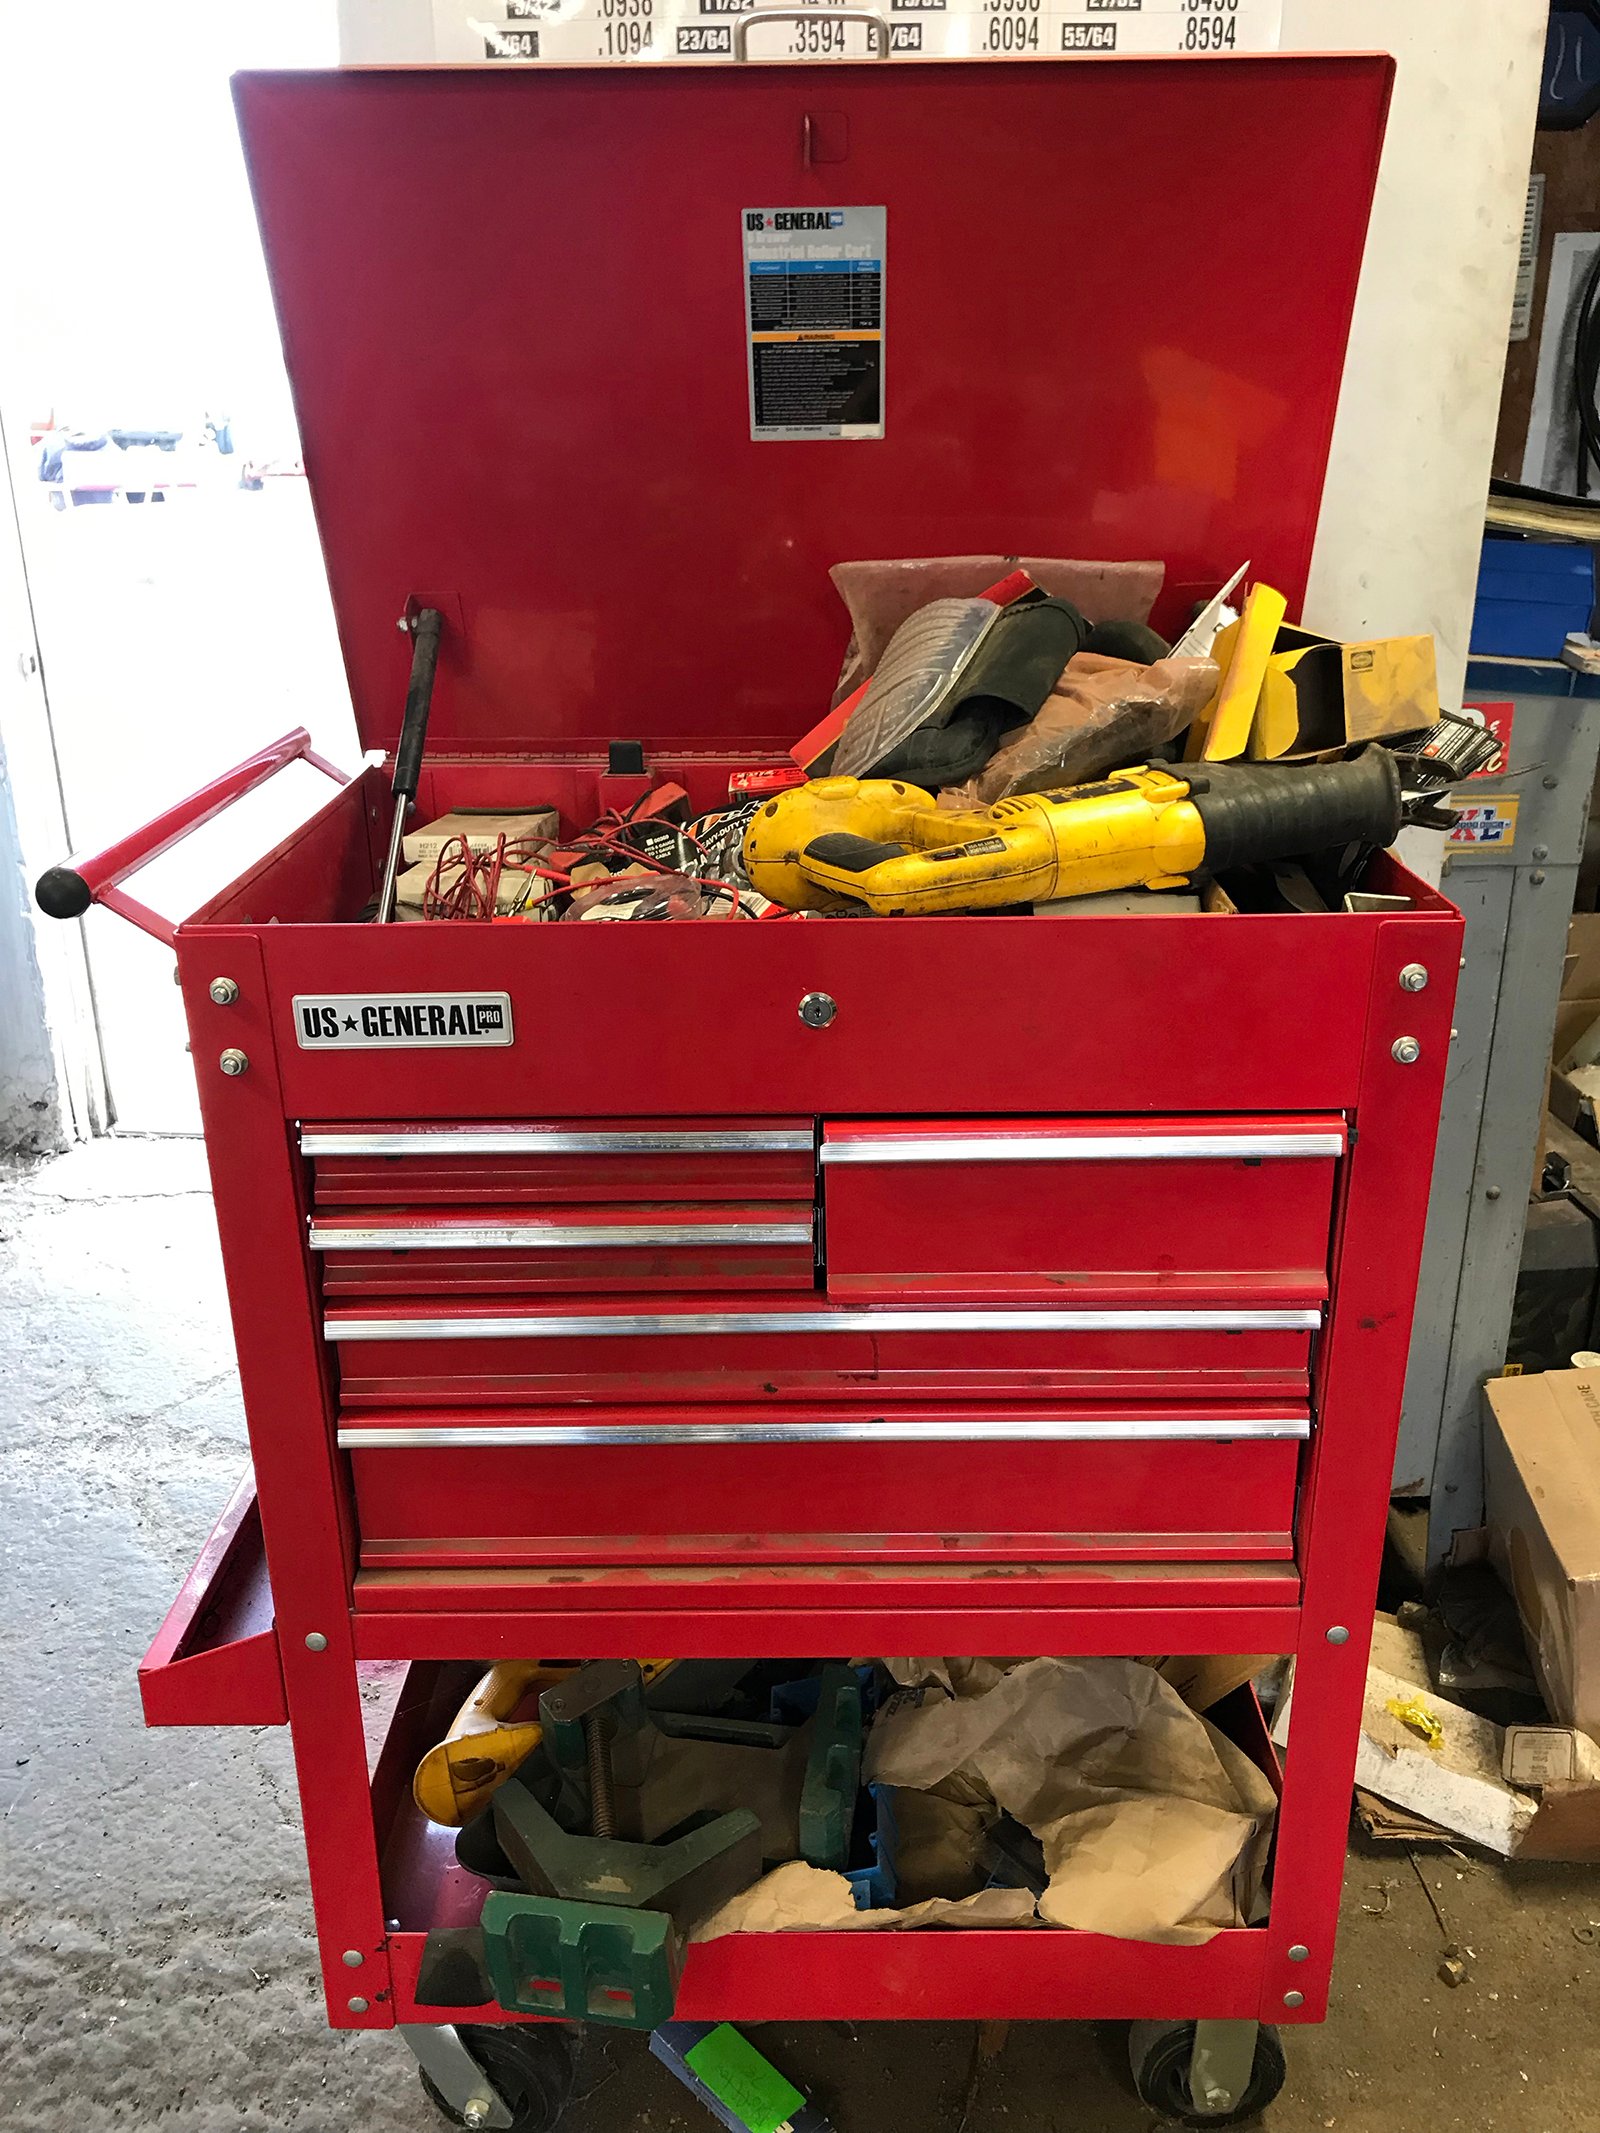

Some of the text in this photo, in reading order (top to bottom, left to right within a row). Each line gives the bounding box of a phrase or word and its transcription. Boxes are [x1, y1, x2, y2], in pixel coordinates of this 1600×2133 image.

[495, 16, 1236, 56] /64 .1094 23/64 .3594 3/64 .6094 55/64 .8594
[746, 213, 764, 231] US
[774, 211, 832, 231] GENERAL
[302, 1004, 500, 1038] US GENERAL PRO
